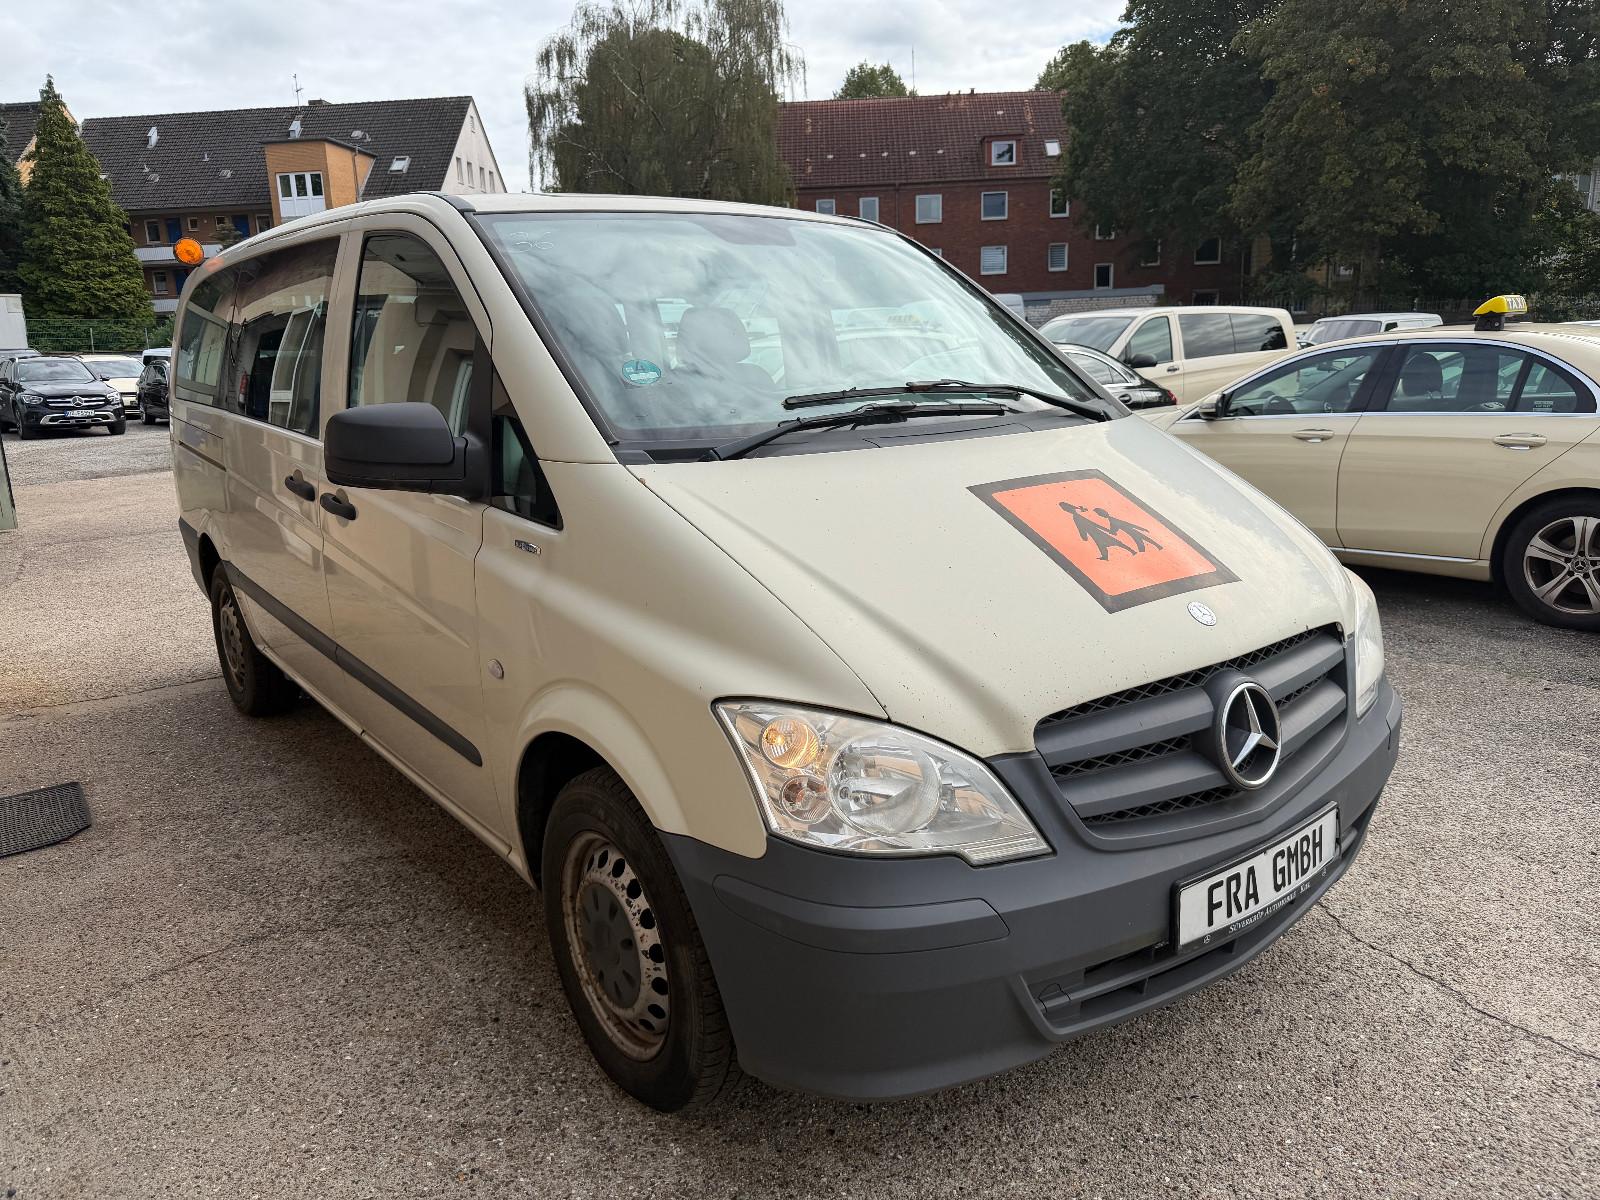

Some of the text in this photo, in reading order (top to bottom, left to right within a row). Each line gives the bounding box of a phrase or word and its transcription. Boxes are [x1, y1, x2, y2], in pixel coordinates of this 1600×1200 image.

[1506, 297, 1526, 310] TAXI
[1207, 824, 1323, 927] FRA GMBH
